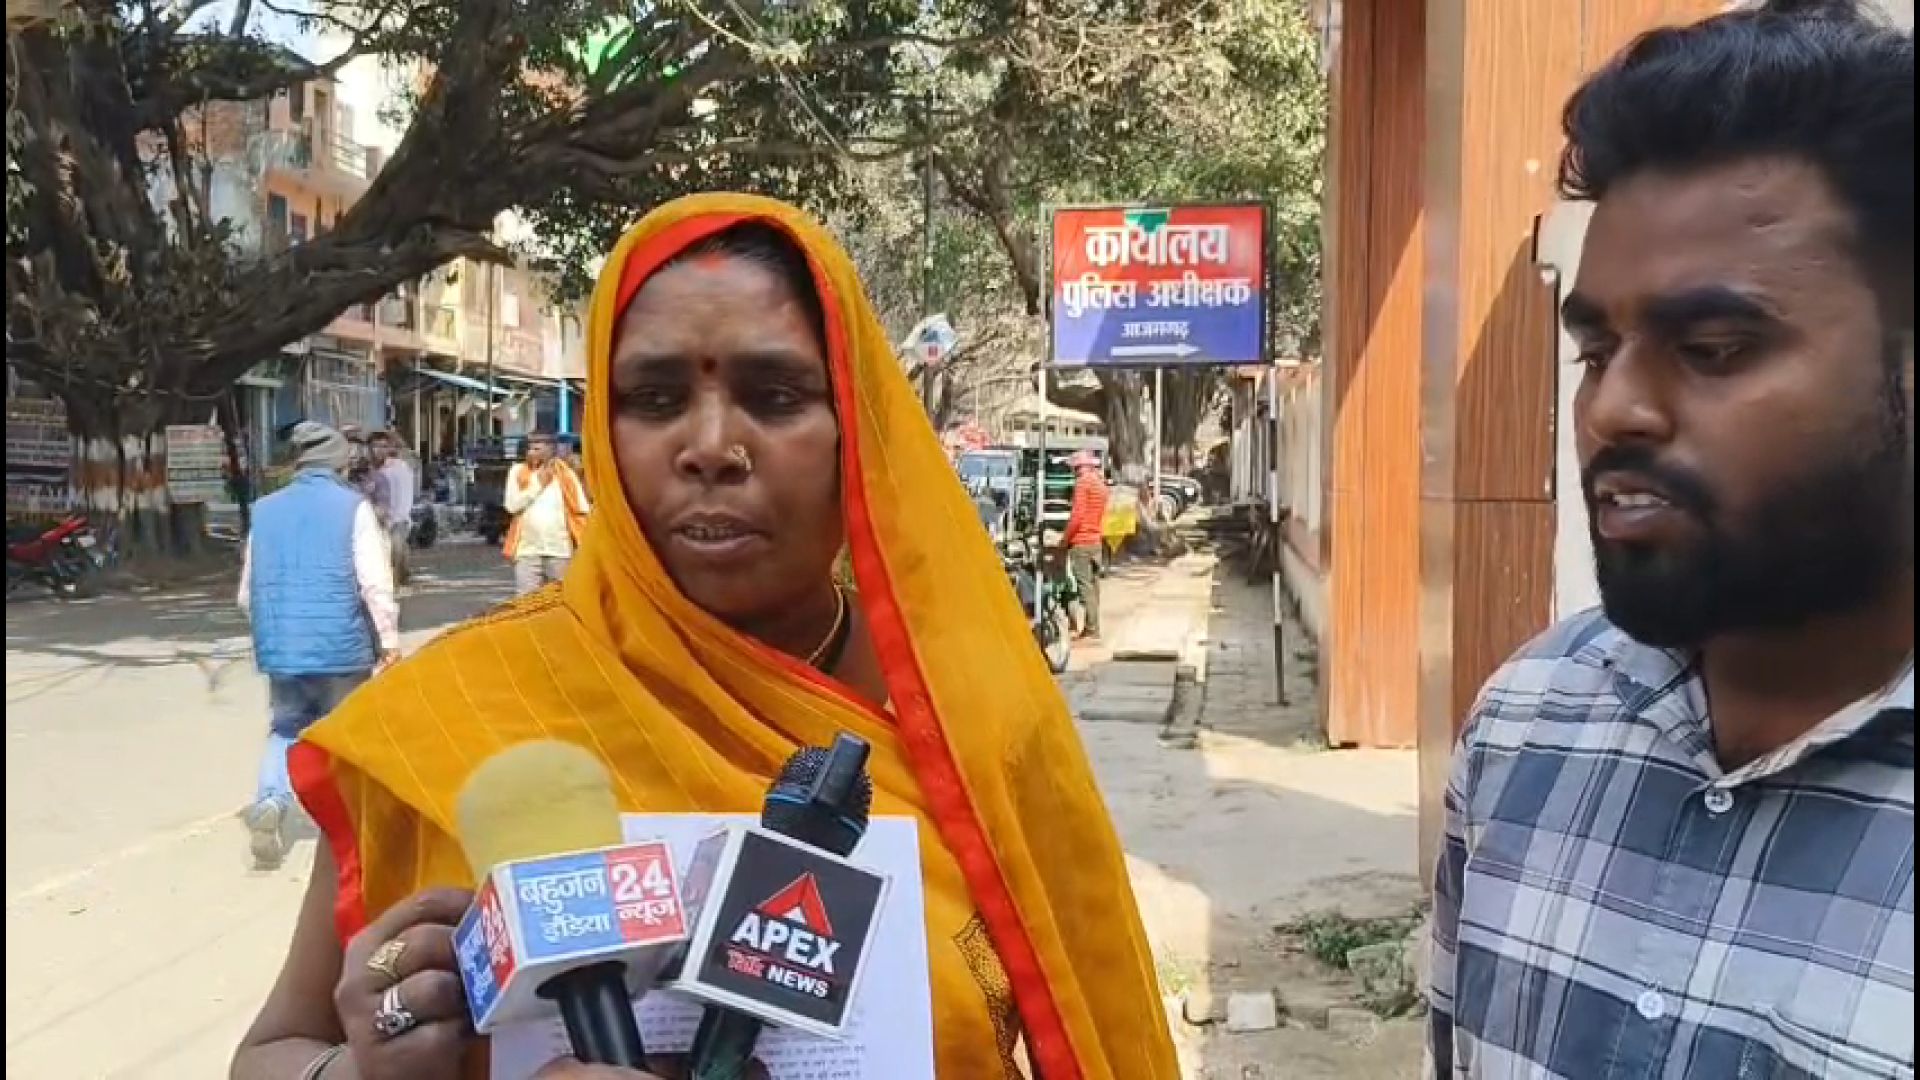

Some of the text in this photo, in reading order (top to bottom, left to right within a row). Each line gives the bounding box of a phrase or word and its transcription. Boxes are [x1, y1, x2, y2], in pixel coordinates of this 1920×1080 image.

[1062, 270, 1251, 318] पुलिस अधीक्षक
[518, 869, 606, 914] बहुजन
[611, 859, 671, 901] 24
[541, 911, 611, 945] इंडिया
[615, 899, 676, 926] न्यूज
[731, 911, 842, 974] APEX
[767, 963, 829, 998] NEWS
